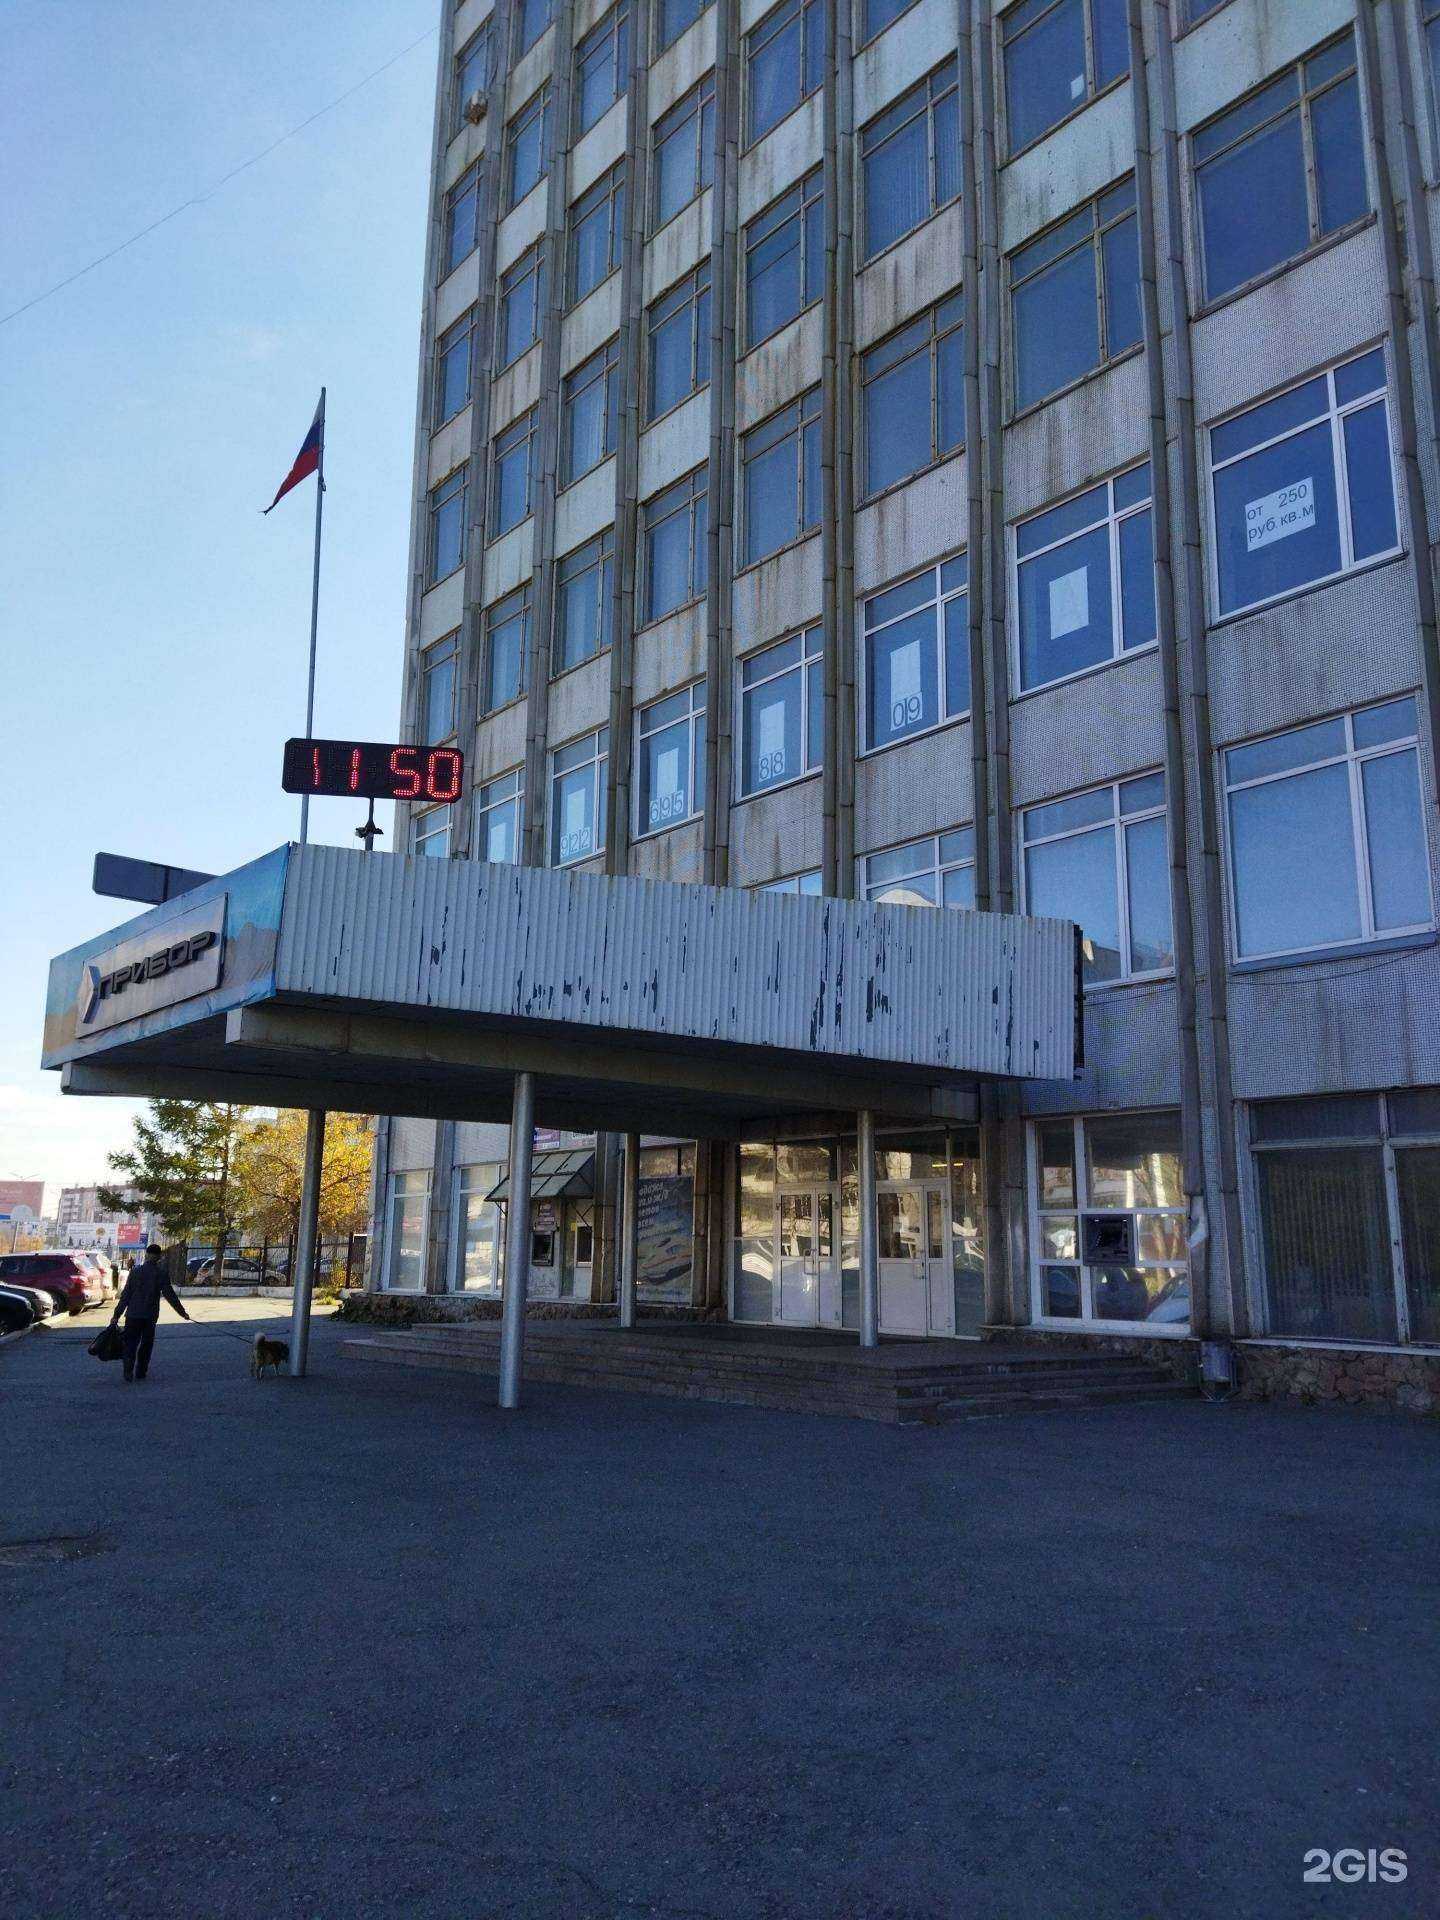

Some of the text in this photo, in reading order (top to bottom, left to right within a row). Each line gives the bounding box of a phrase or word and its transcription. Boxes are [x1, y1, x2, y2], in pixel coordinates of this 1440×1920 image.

[1247, 484, 1308, 521] от 250
[650, 790, 684, 822] 695
[99, 930, 217, 1001] ПРИБОР
